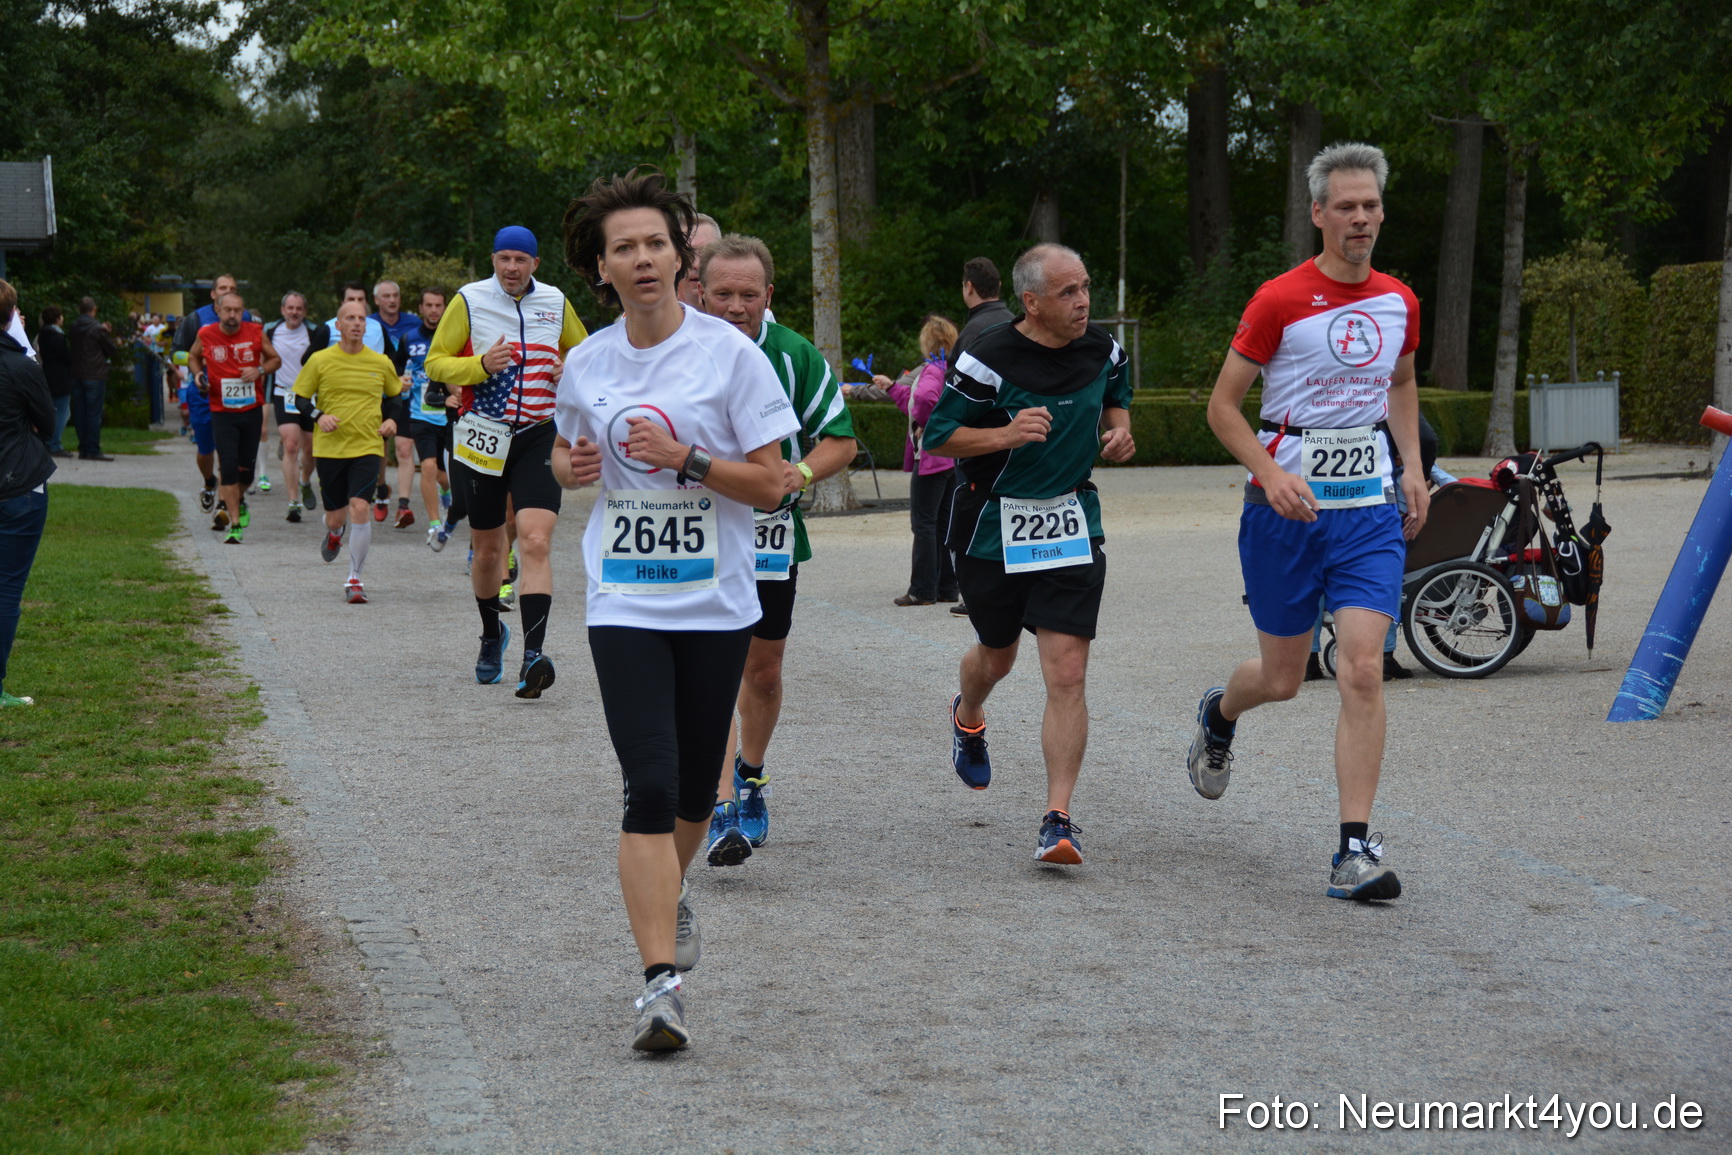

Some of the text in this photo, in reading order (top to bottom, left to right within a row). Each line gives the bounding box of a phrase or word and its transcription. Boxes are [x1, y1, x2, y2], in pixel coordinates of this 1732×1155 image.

[1349, 376, 1369, 385] MIT
[225, 385, 252, 397] 2211
[466, 428, 499, 455] 253
[1304, 435, 1370, 445] PARTL Neumarkt
[1310, 445, 1375, 478] 2223
[1323, 485, 1366, 499] Rüdiger
[607, 499, 694, 511] PARTL Neumarkt
[1010, 509, 1080, 542] 2226
[612, 515, 705, 555] 2645
[1031, 545, 1064, 560] Frank
[636, 564, 679, 580] Heike
